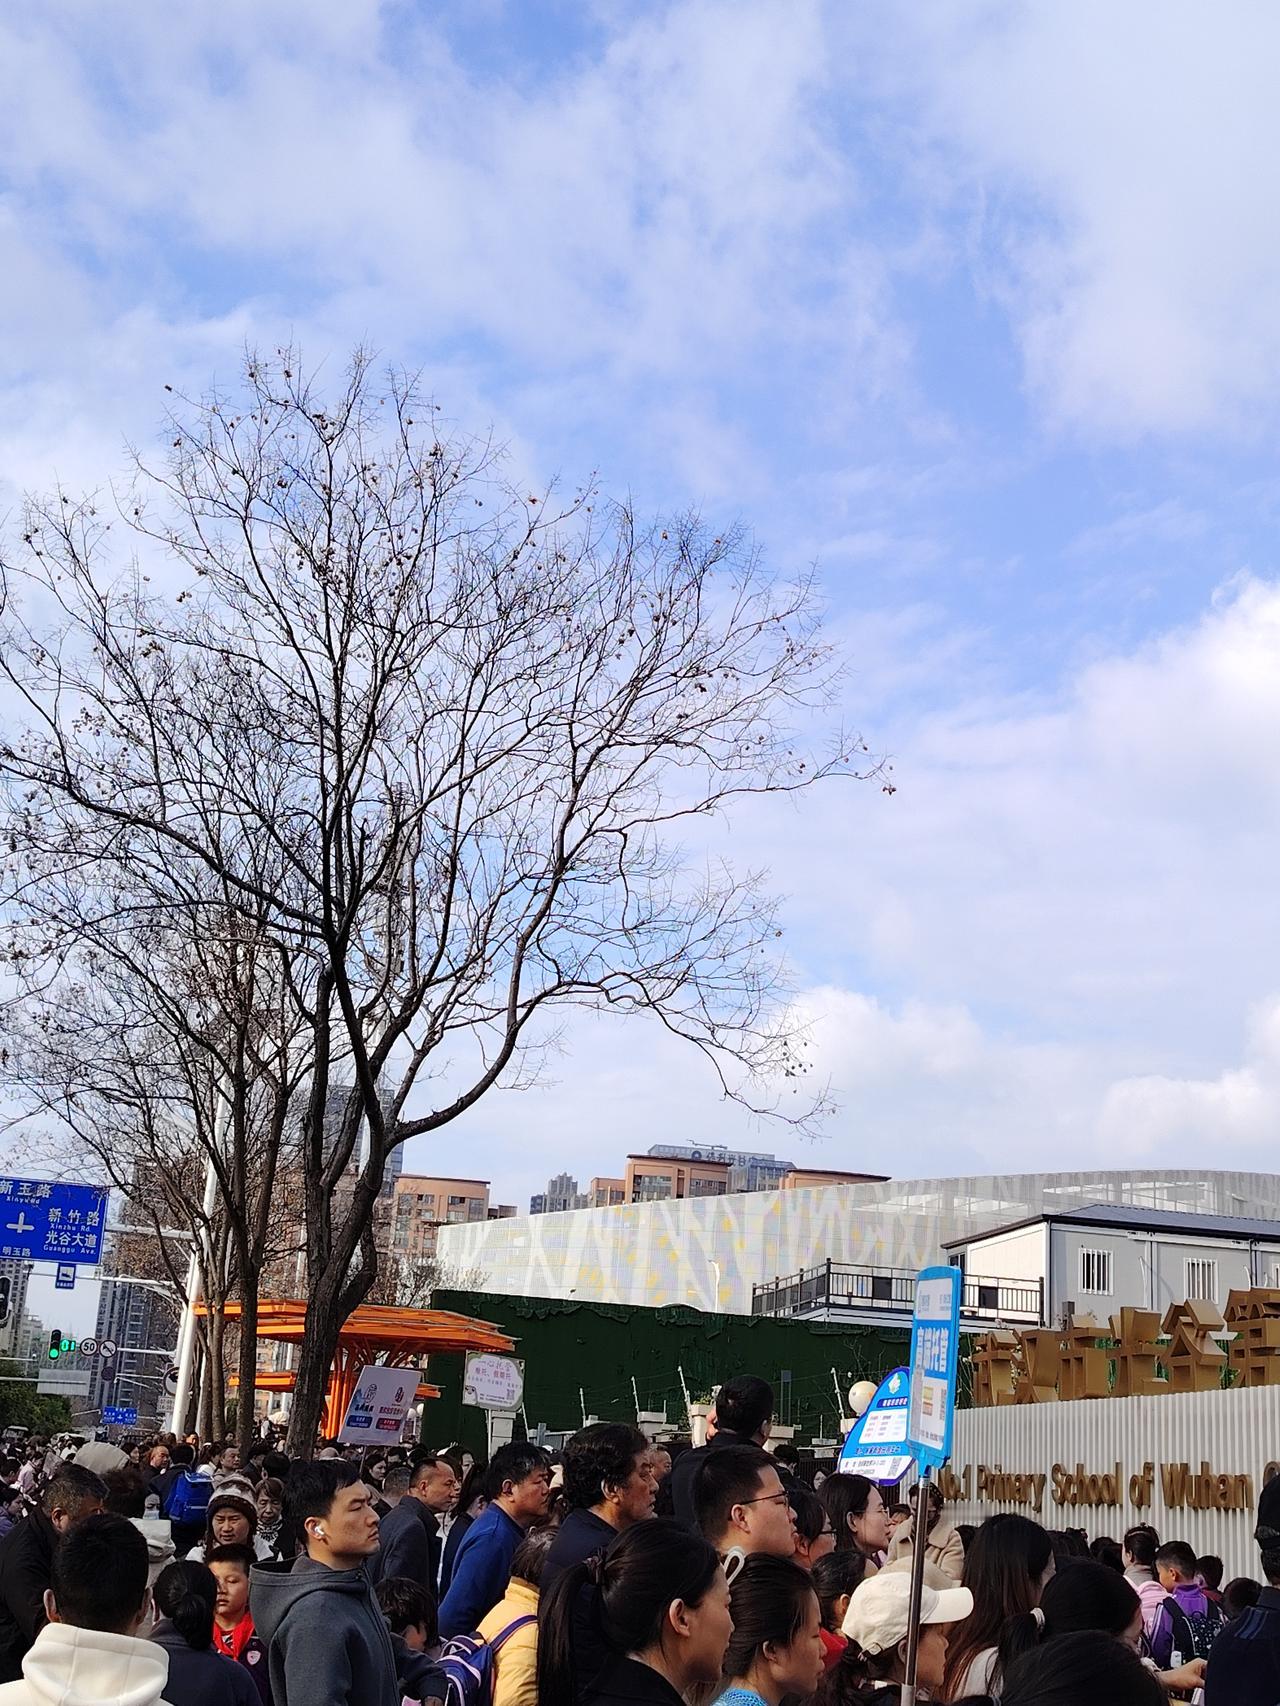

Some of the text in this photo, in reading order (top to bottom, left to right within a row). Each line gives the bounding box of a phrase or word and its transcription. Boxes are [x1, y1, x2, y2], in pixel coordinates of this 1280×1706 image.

[0, 1180, 53, 1198] 新玉路
[48, 1207, 100, 1227] 新竹路
[50, 1223, 76, 1231] Xinzhu
[45, 1230, 97, 1248] 光谷大道
[43, 1244, 76, 1254] Guanggu
[83, 1342, 95, 1352] 50
[938, 1464, 972, 1501] No.1
[977, 1464, 1046, 1513] Primary
[1051, 1462, 1123, 1505] School
[1129, 1461, 1154, 1506] of
[1160, 1461, 1254, 1510] Wuhan
